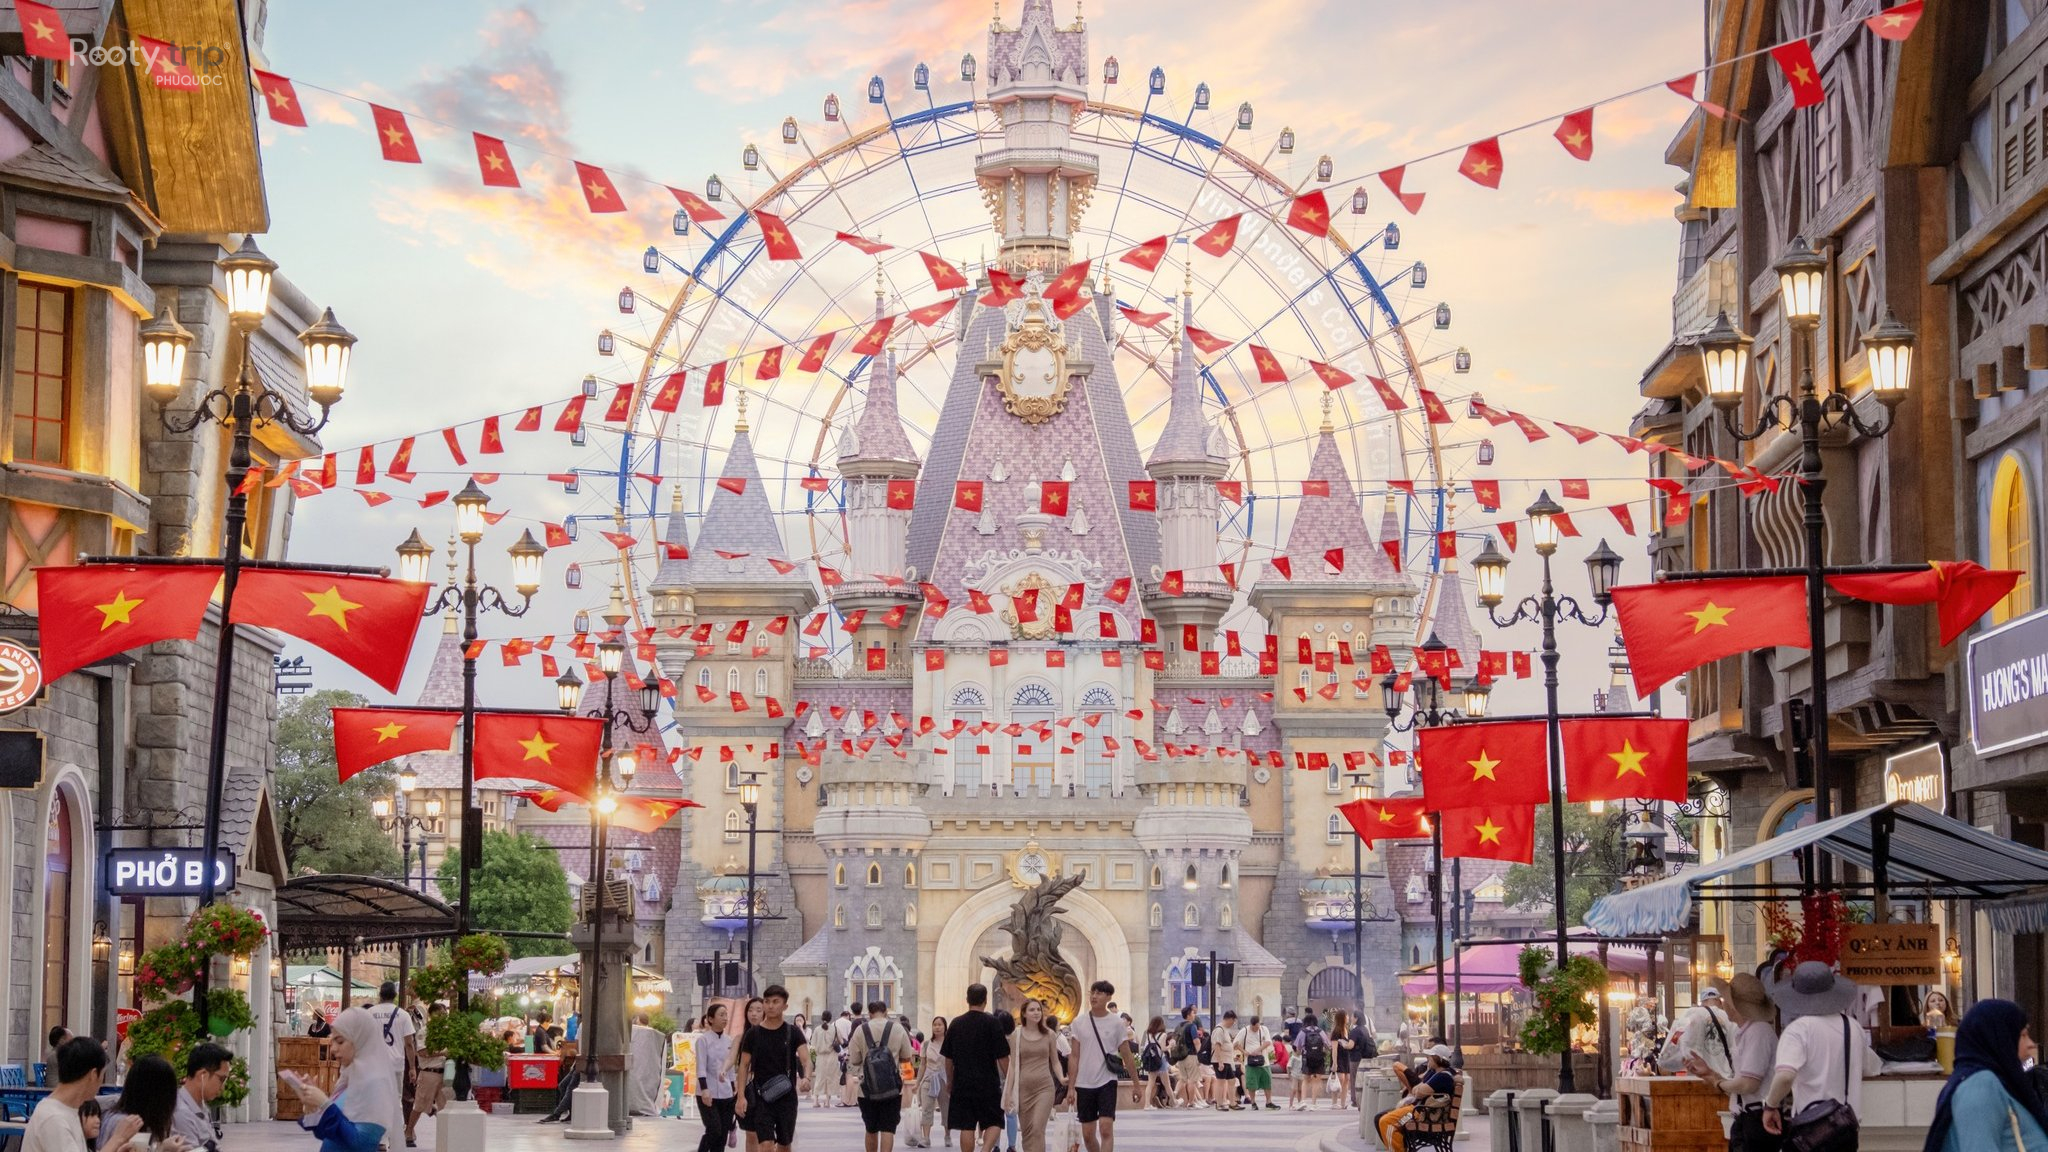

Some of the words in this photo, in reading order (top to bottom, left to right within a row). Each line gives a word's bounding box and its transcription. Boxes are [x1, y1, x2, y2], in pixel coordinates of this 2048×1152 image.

[2031, 652, 2048, 697] MA
[116, 853, 177, 887] PHỞ
[1847, 967, 1883, 976] PHOTO
[1885, 966, 1935, 976] COUNTER
